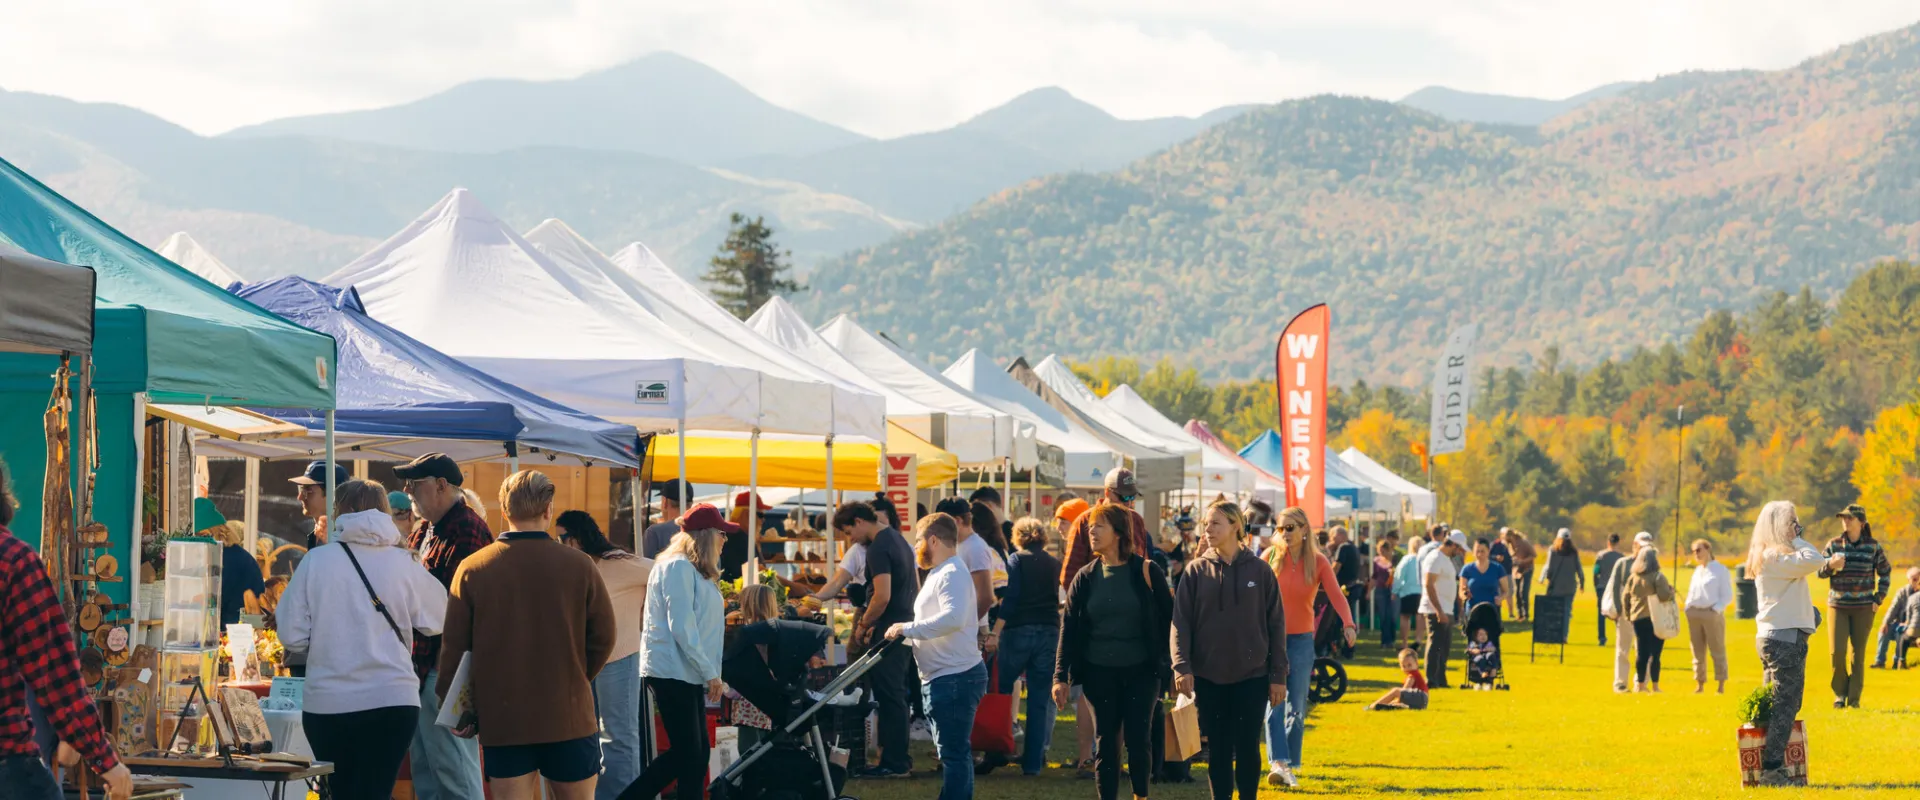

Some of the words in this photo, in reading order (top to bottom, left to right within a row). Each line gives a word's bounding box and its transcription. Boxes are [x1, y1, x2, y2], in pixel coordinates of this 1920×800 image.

[1286, 334, 1318, 499] WINERY
[1444, 354, 1464, 441] CIDER
[887, 456, 911, 532] VEG
